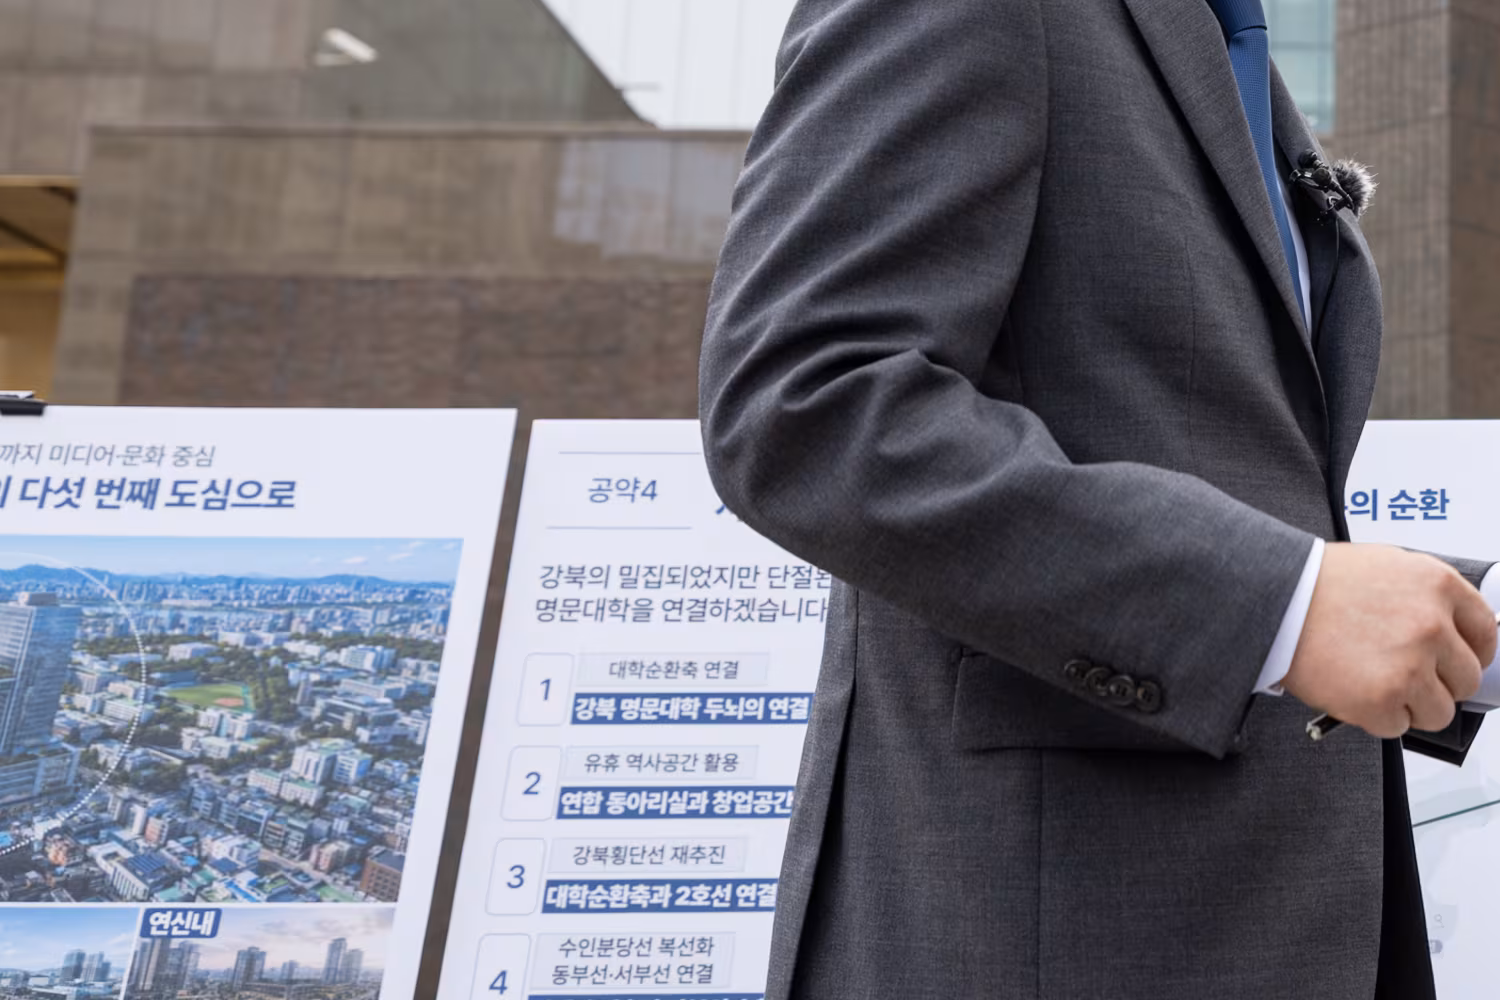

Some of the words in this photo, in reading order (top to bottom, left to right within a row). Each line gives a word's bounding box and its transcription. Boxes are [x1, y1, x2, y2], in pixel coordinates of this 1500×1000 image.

[171, 445, 217, 468] 중심
[18, 475, 86, 510] 다섯
[94, 476, 161, 511] 번째
[164, 478, 297, 511] 도심으로
[587, 476, 659, 504] 공약4
[1387, 488, 1452, 521] 순환
[538, 564, 611, 590] 강북의
[617, 564, 762, 590] 밀집되었지만
[534, 597, 655, 624] 명문대학을
[661, 597, 829, 623] 연결하겠습니다
[608, 660, 699, 680] 대학순환축
[703, 660, 741, 680] 연결
[539, 678, 552, 702] 1
[574, 697, 618, 721] 강북
[619, 697, 701, 721] 명문대학
[703, 697, 766, 721] 두뇌의
[767, 697, 812, 721] 연결
[583, 753, 621, 774] 유휴
[625, 753, 700, 774] 역사공간
[703, 753, 740, 774] 활용
[522, 771, 542, 796] 2
[560, 791, 604, 816] 연합
[605, 790, 709, 815] 동아리실과
[711, 790, 795, 815] 창업공간
[572, 845, 665, 866] 강북횡단선
[669, 844, 727, 866] 재추진
[506, 864, 526, 889] 3
[545, 885, 673, 909] 대학순환축과
[674, 884, 733, 909] 2호선
[734, 883, 779, 908] 연결
[149, 910, 217, 937] 연신내
[558, 937, 653, 959] 수인분당선
[657, 937, 715, 959] 복선화
[488, 970, 509, 995] 4
[676, 963, 714, 985] 연결
